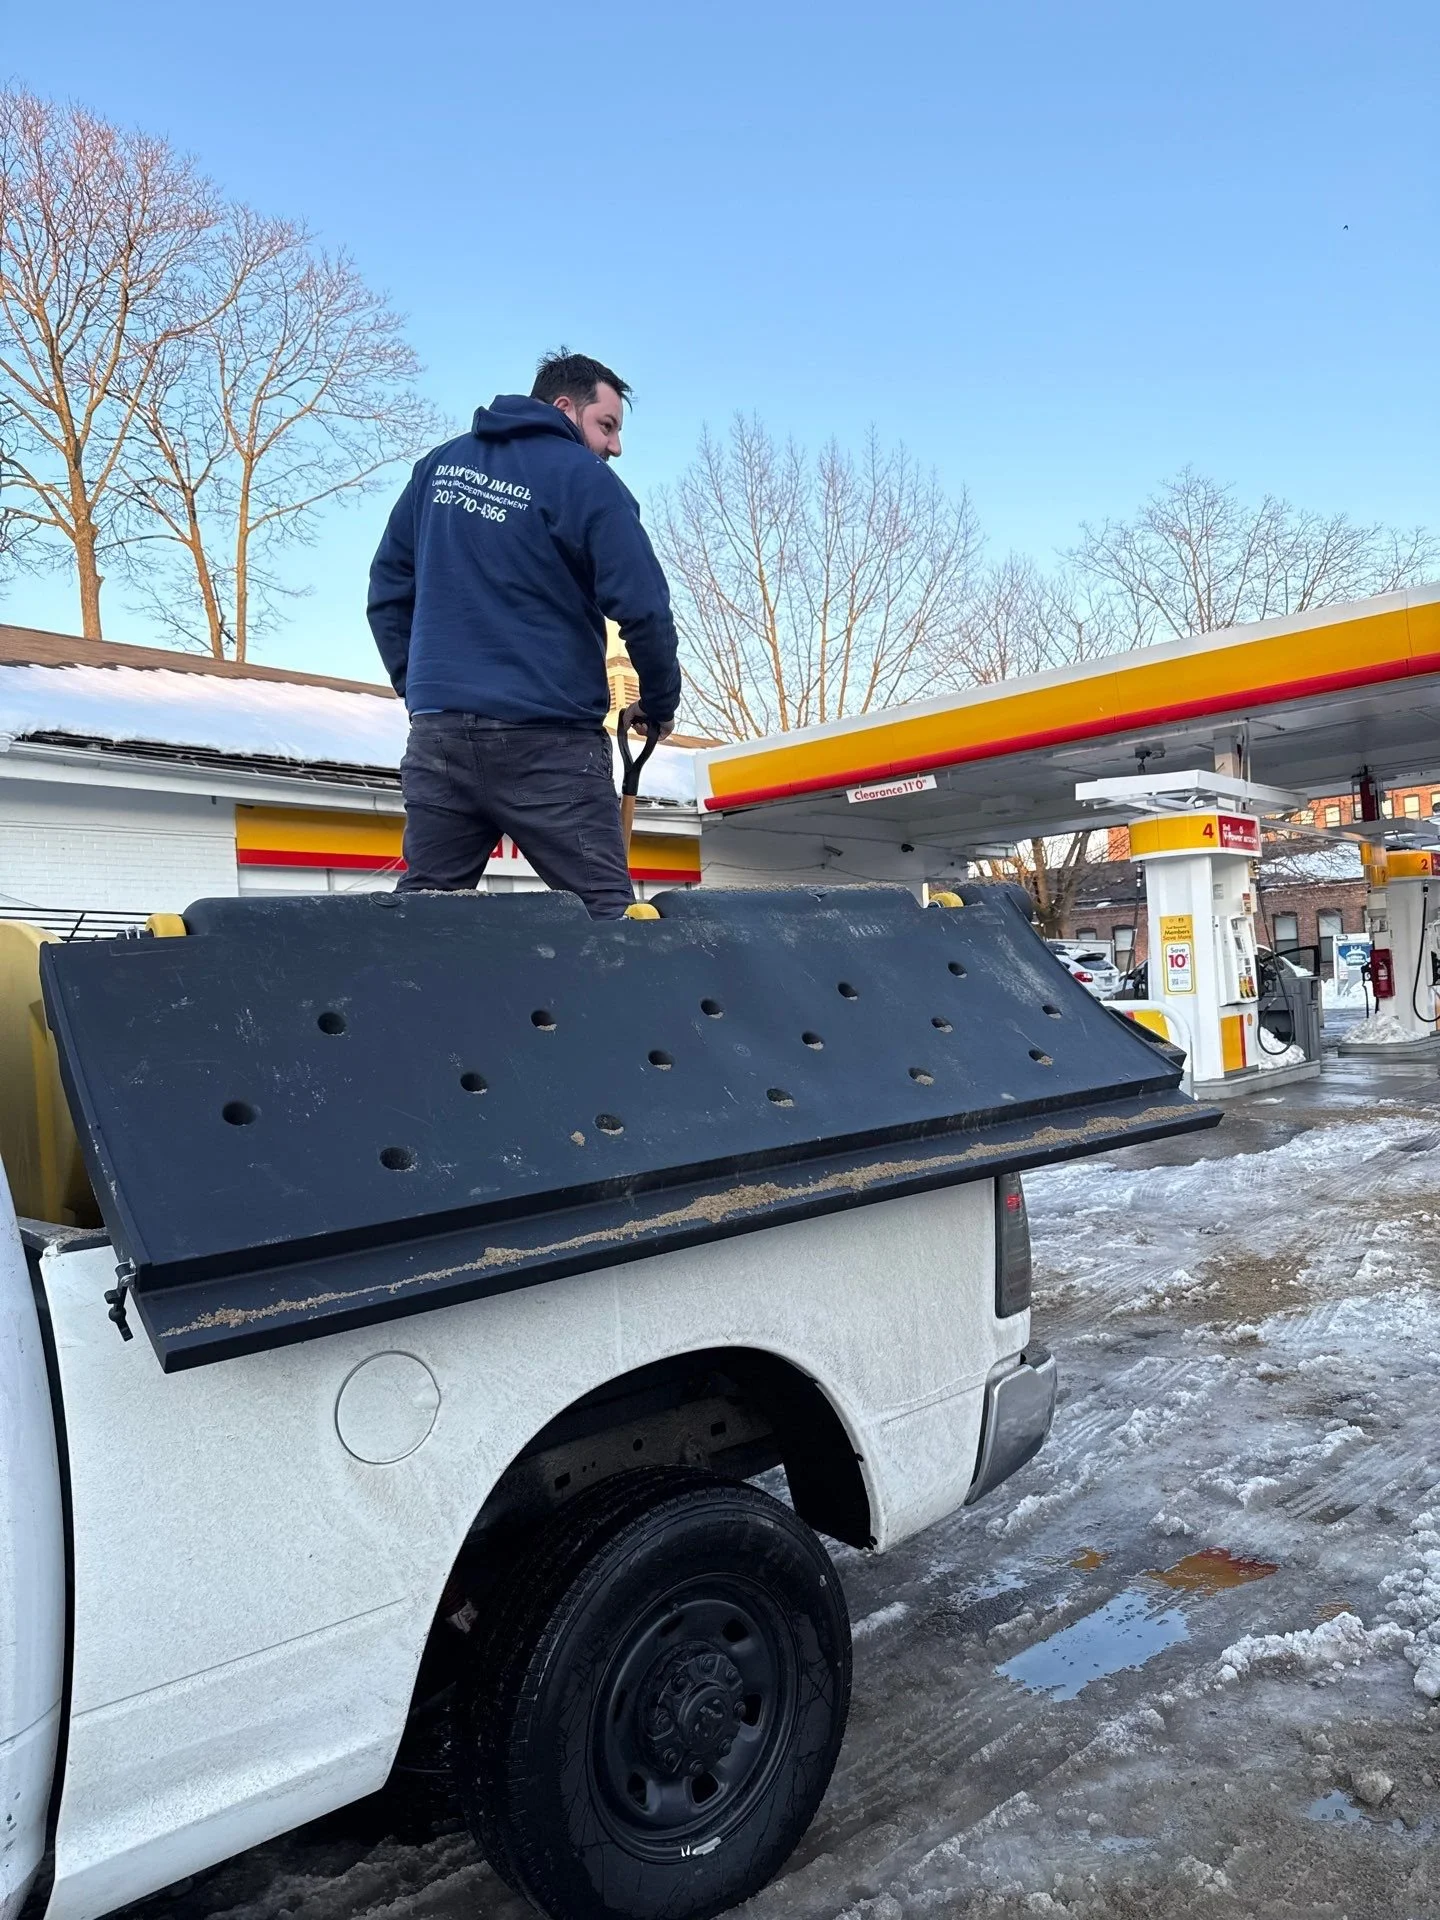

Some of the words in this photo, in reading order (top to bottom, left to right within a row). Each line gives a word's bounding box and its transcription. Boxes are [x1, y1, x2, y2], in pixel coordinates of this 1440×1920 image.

[854, 786, 903, 801] Clearance
[1202, 823, 1214, 839] 4
[1421, 858, 1429, 870] 2
